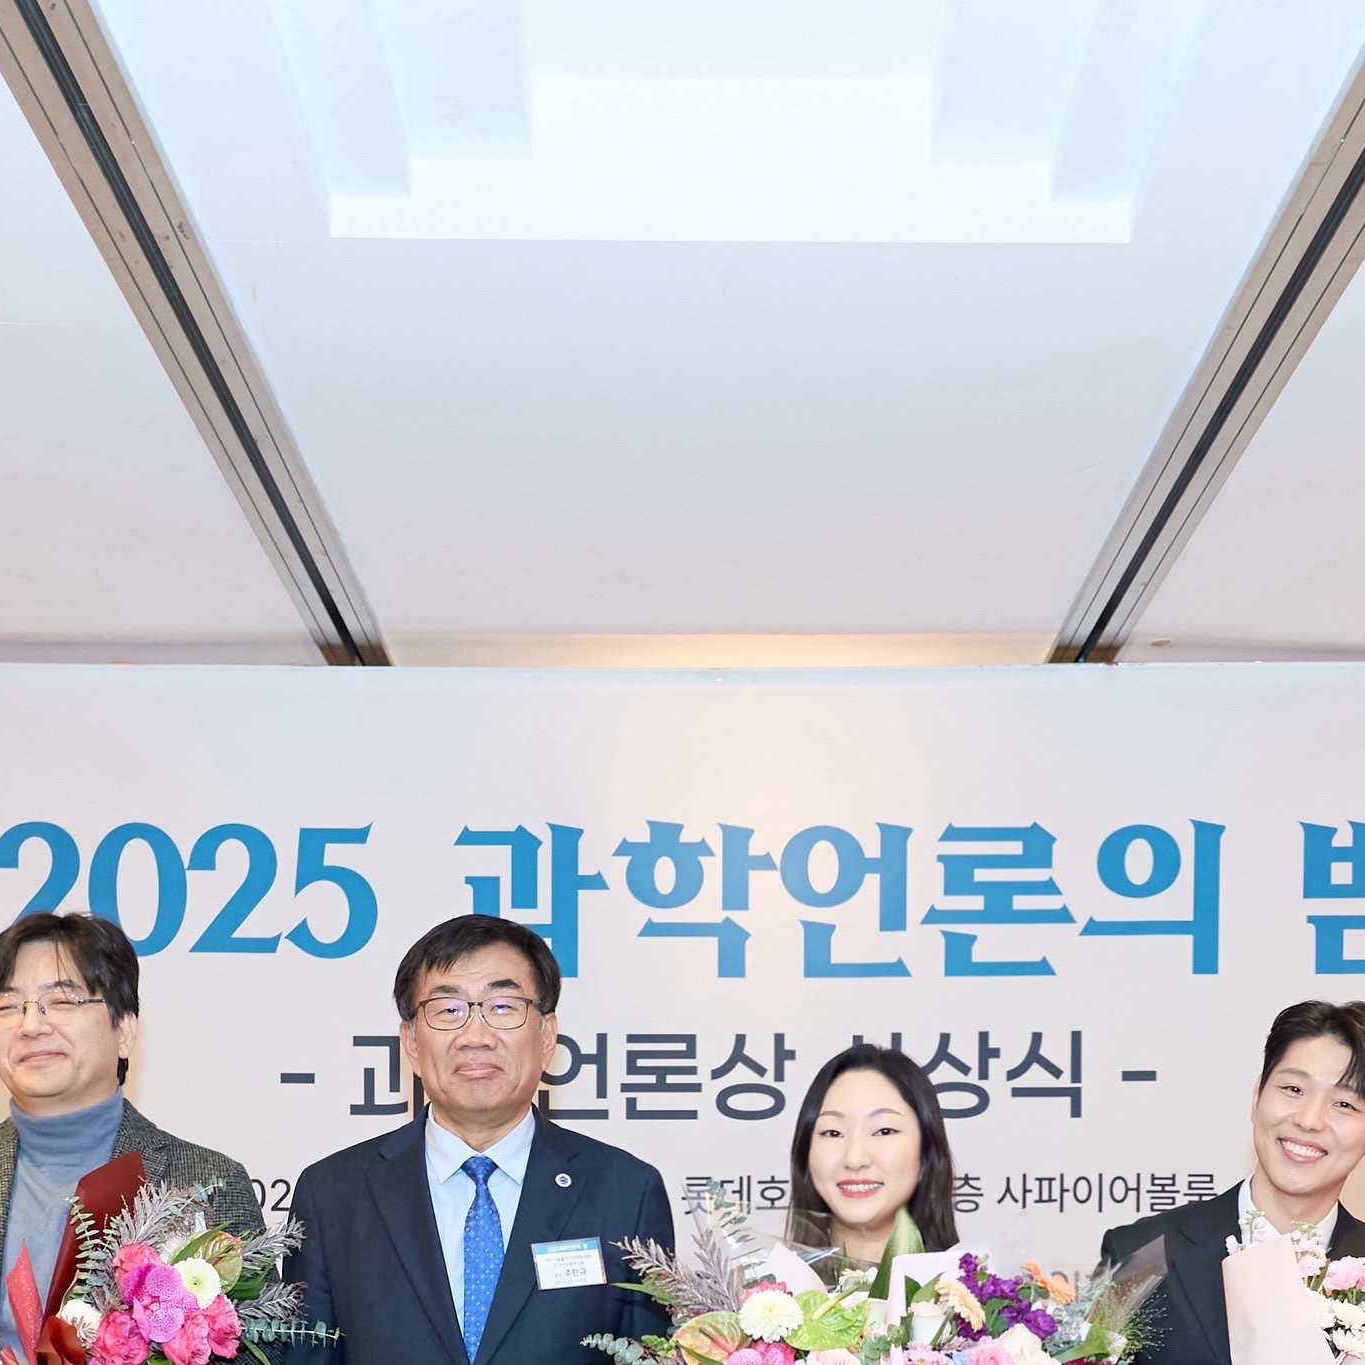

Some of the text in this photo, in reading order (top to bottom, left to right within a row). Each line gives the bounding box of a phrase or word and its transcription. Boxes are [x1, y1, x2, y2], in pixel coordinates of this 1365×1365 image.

[454, 819, 1225, 978] 과학언론의
[350, 1033, 796, 1121] 과언론상
[852, 1031, 1082, 1120] 상식
[681, 1175, 790, 1214] 롯데호
